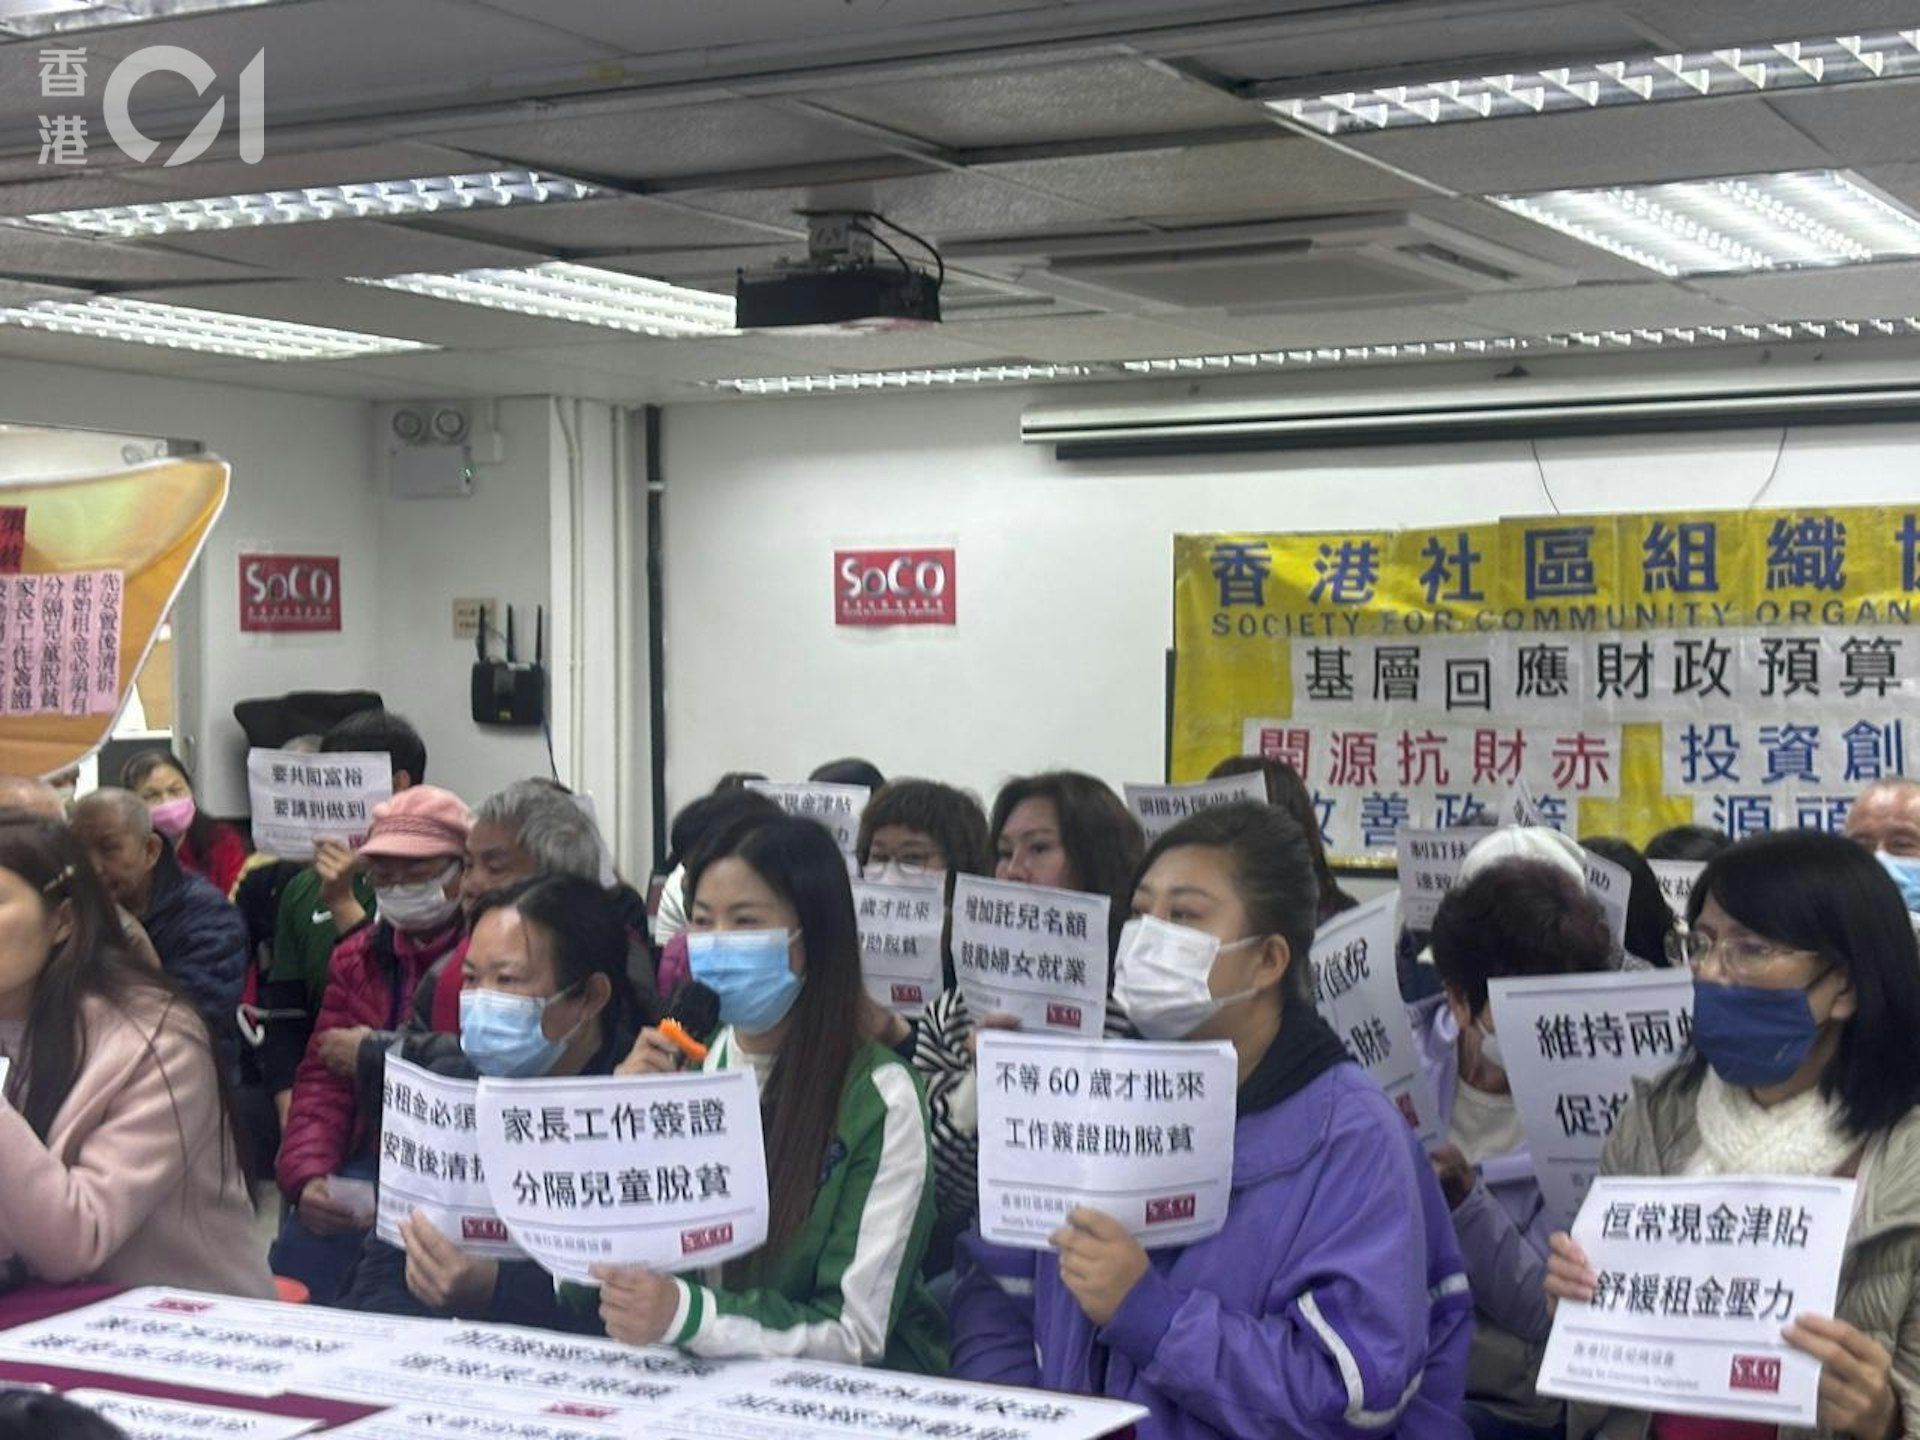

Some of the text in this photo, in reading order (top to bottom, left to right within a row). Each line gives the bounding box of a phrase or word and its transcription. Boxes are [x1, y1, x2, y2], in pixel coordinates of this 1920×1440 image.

[1211, 598, 1912, 637] SOCIETY FOR COMMUNITY ORGAN
[1306, 635, 1903, 711] 基層回應財政預算
[1260, 719, 1904, 791] 開源抗財赤 投資創
[771, 791, 852, 816] 現金津貼
[860, 931, 919, 958] 助脫貧
[1310, 936, 1371, 1003] 值稅
[995, 1061, 1206, 1101] 不等 60 歲才批來
[501, 1096, 727, 1144] 家長工作簽證
[1004, 1116, 1195, 1157] 工作簽證助脫貧
[512, 1162, 733, 1210] 分隔兒童脫貧
[1601, 1198, 1813, 1250] 恒常現金津貼
[1588, 1270, 1796, 1323] 舒緩租金壓力
